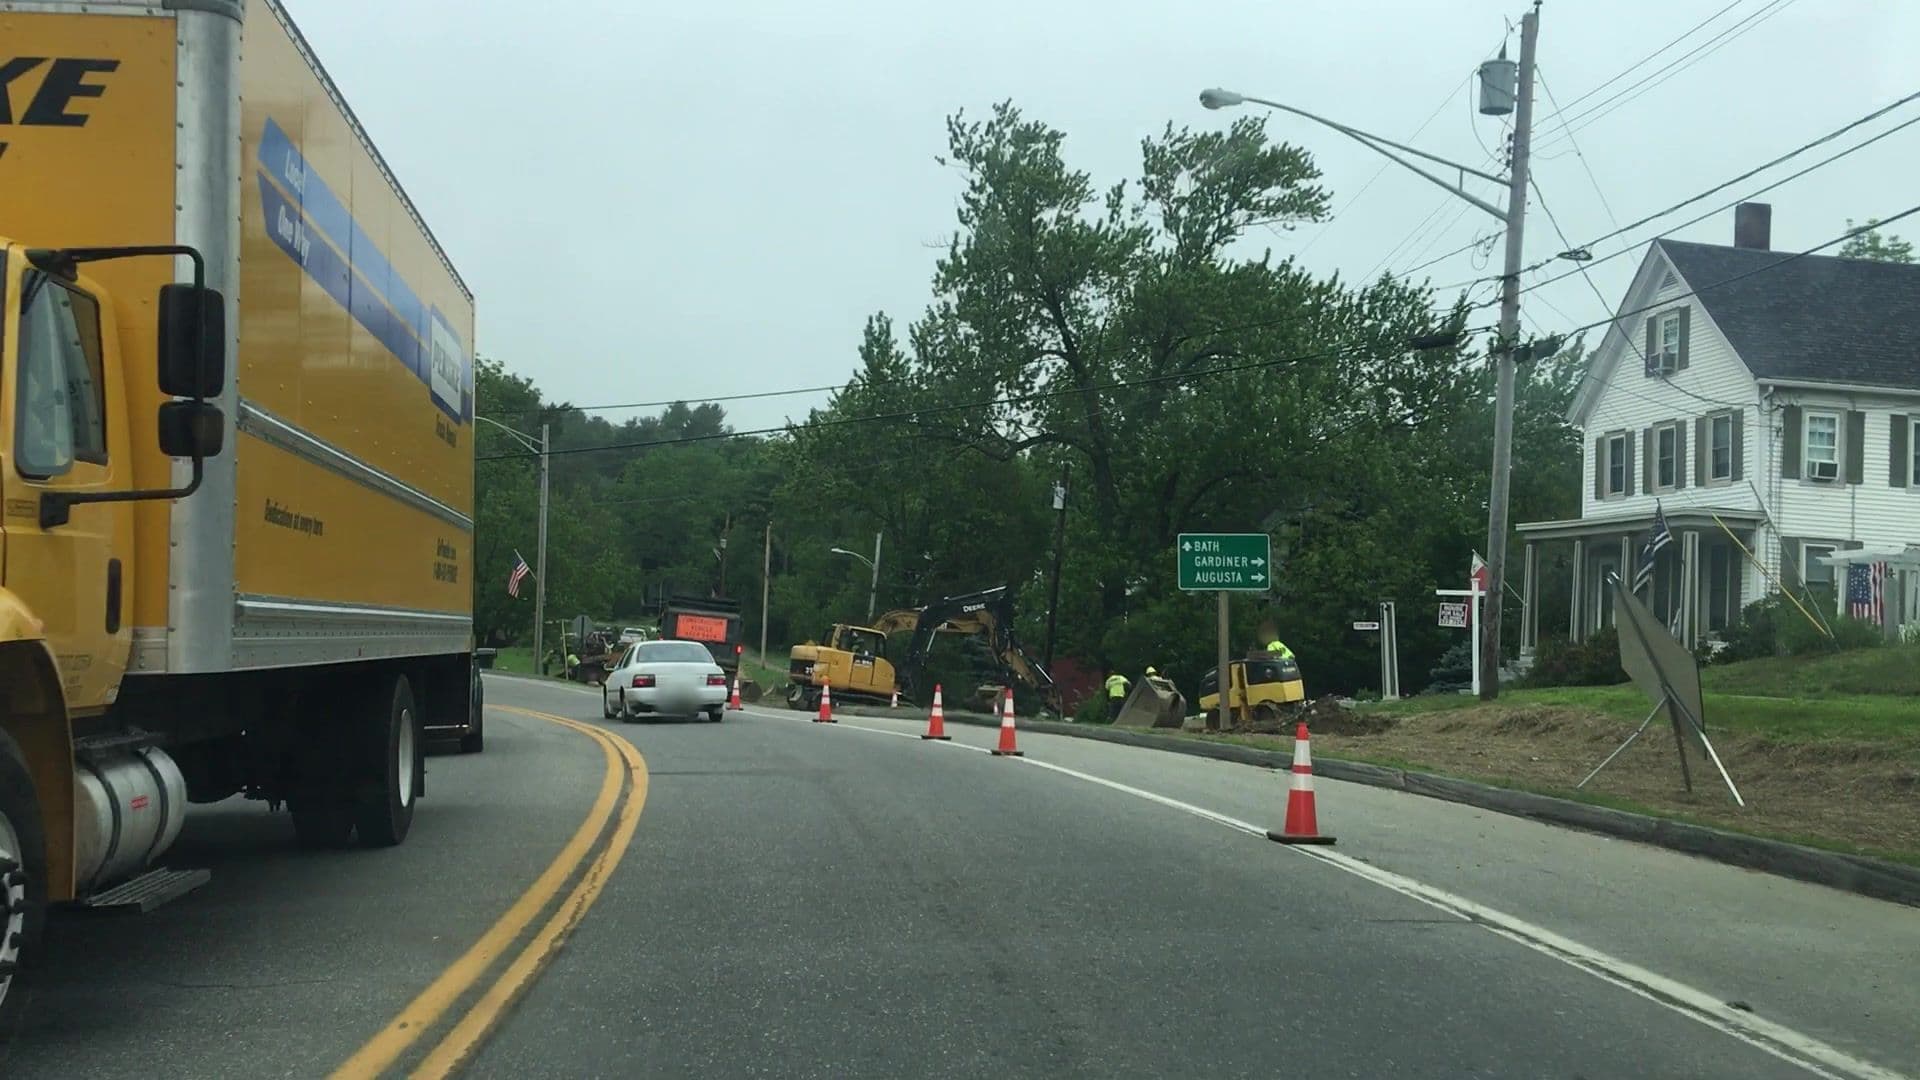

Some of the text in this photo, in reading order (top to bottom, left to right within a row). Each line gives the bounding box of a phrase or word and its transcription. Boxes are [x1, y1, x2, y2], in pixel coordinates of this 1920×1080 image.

[1194, 541, 1220, 552] BATH
[1194, 556, 1248, 568] GARDINER
[1195, 571, 1242, 583] AUGUSTA
[962, 602, 986, 613] DEERE
